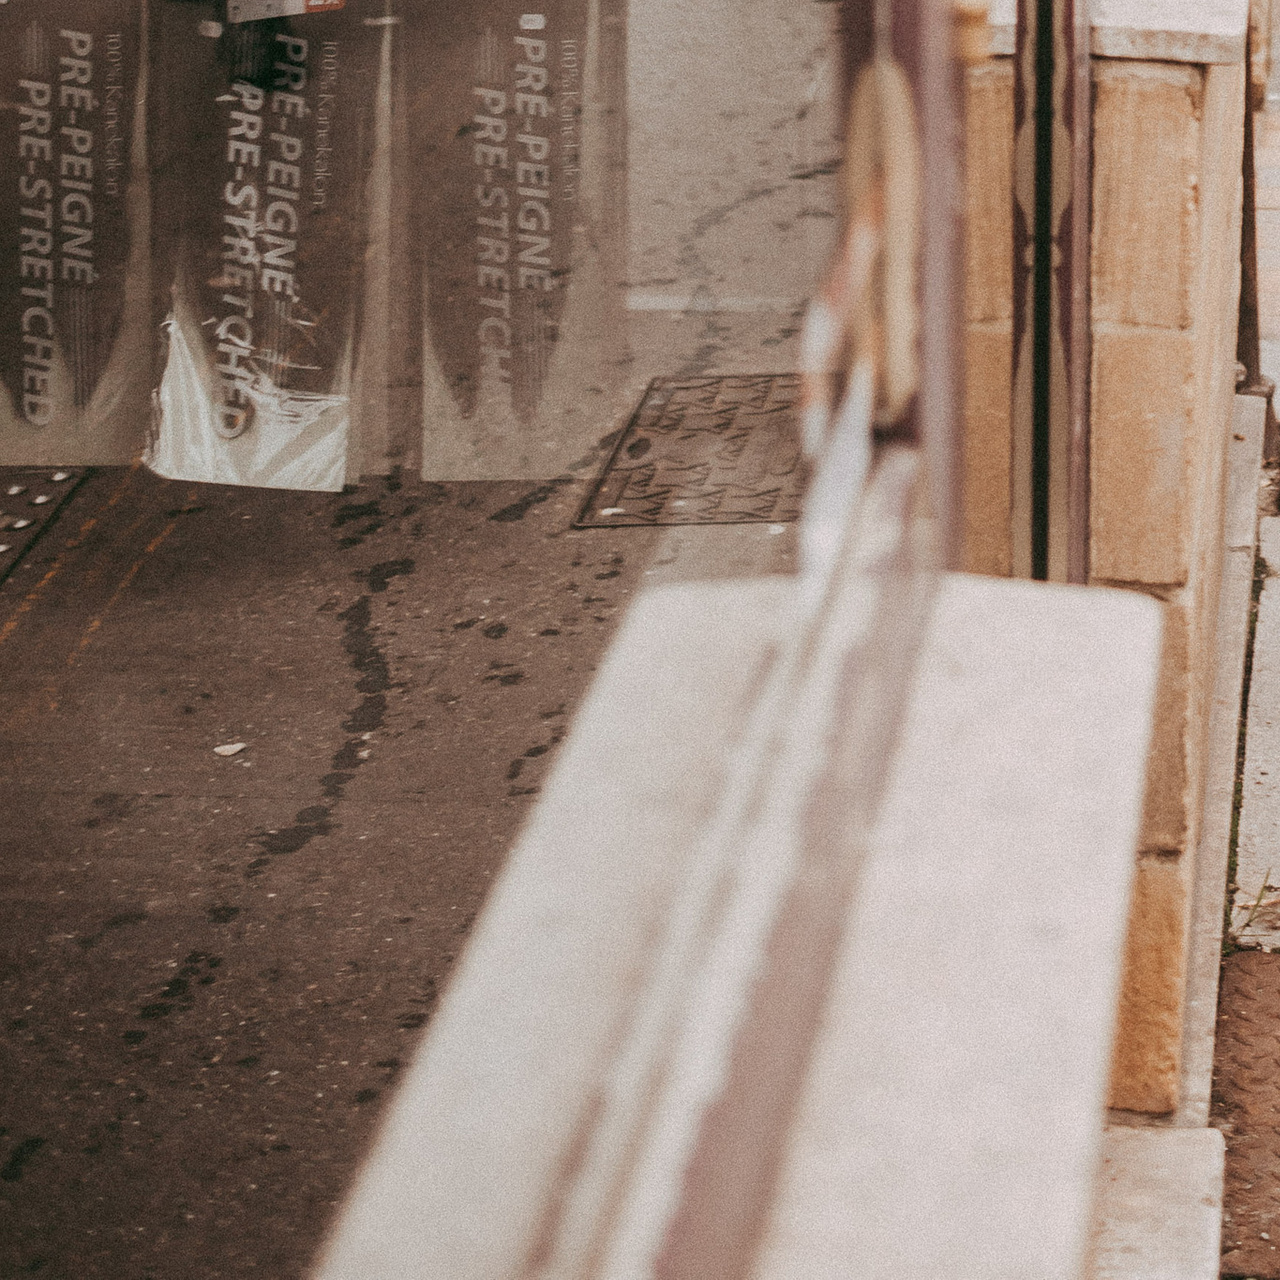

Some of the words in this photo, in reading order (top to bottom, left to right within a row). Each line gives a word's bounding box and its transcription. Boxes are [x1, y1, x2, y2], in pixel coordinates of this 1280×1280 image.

[18, 79, 55, 426] PRE-STRETCHED
[60, 29, 99, 284] PRÉ-PEIGNÉ
[212, 80, 264, 439] PRE-STRETCHED
[261, 33, 310, 303] PRÉ-PEIGNÉ
[473, 86, 514, 428] PRE-STRETCH
[514, 36, 554, 292] PRÉ-PEIGNÉ
